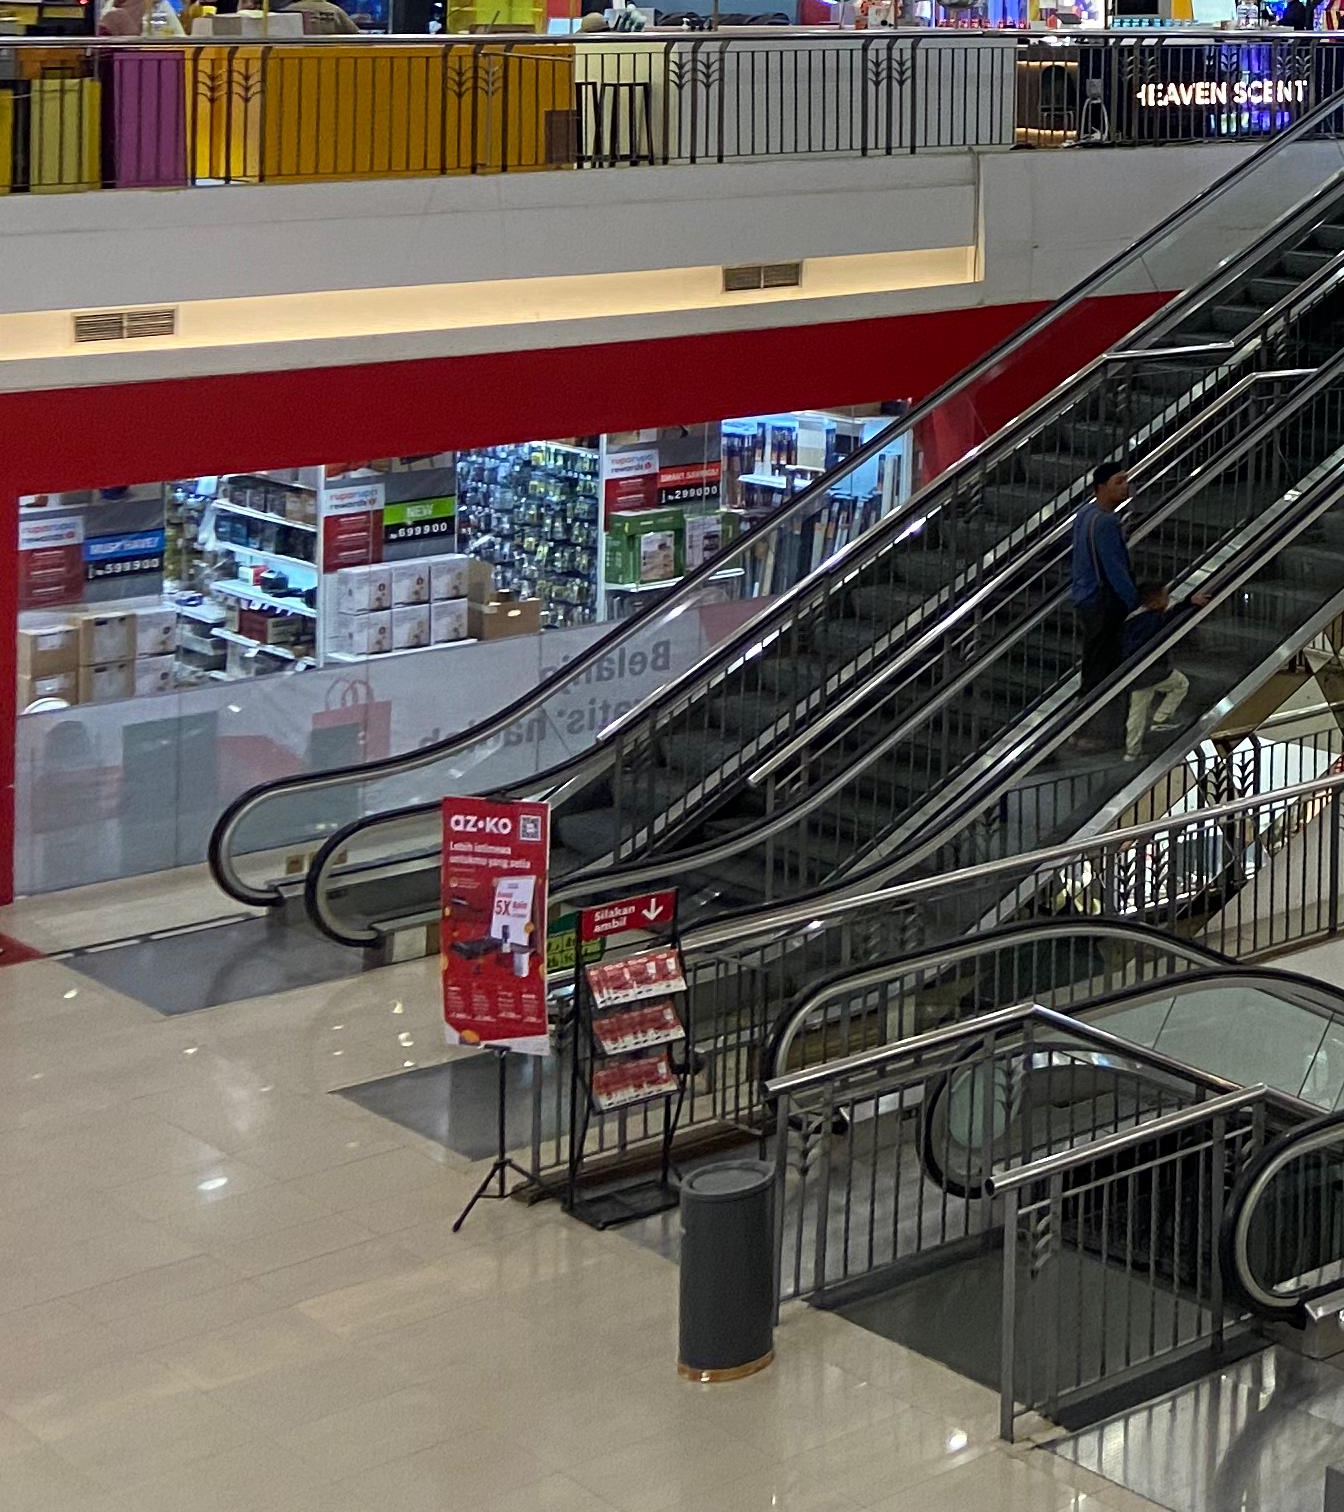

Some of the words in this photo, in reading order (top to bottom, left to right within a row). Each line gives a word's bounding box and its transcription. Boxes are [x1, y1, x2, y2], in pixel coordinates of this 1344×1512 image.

[1137, 80, 1228, 106] HEAVEN
[1233, 79, 1308, 104] SCENT
[594, 905, 636, 922] Silakan
[594, 916, 627, 933] ambil
